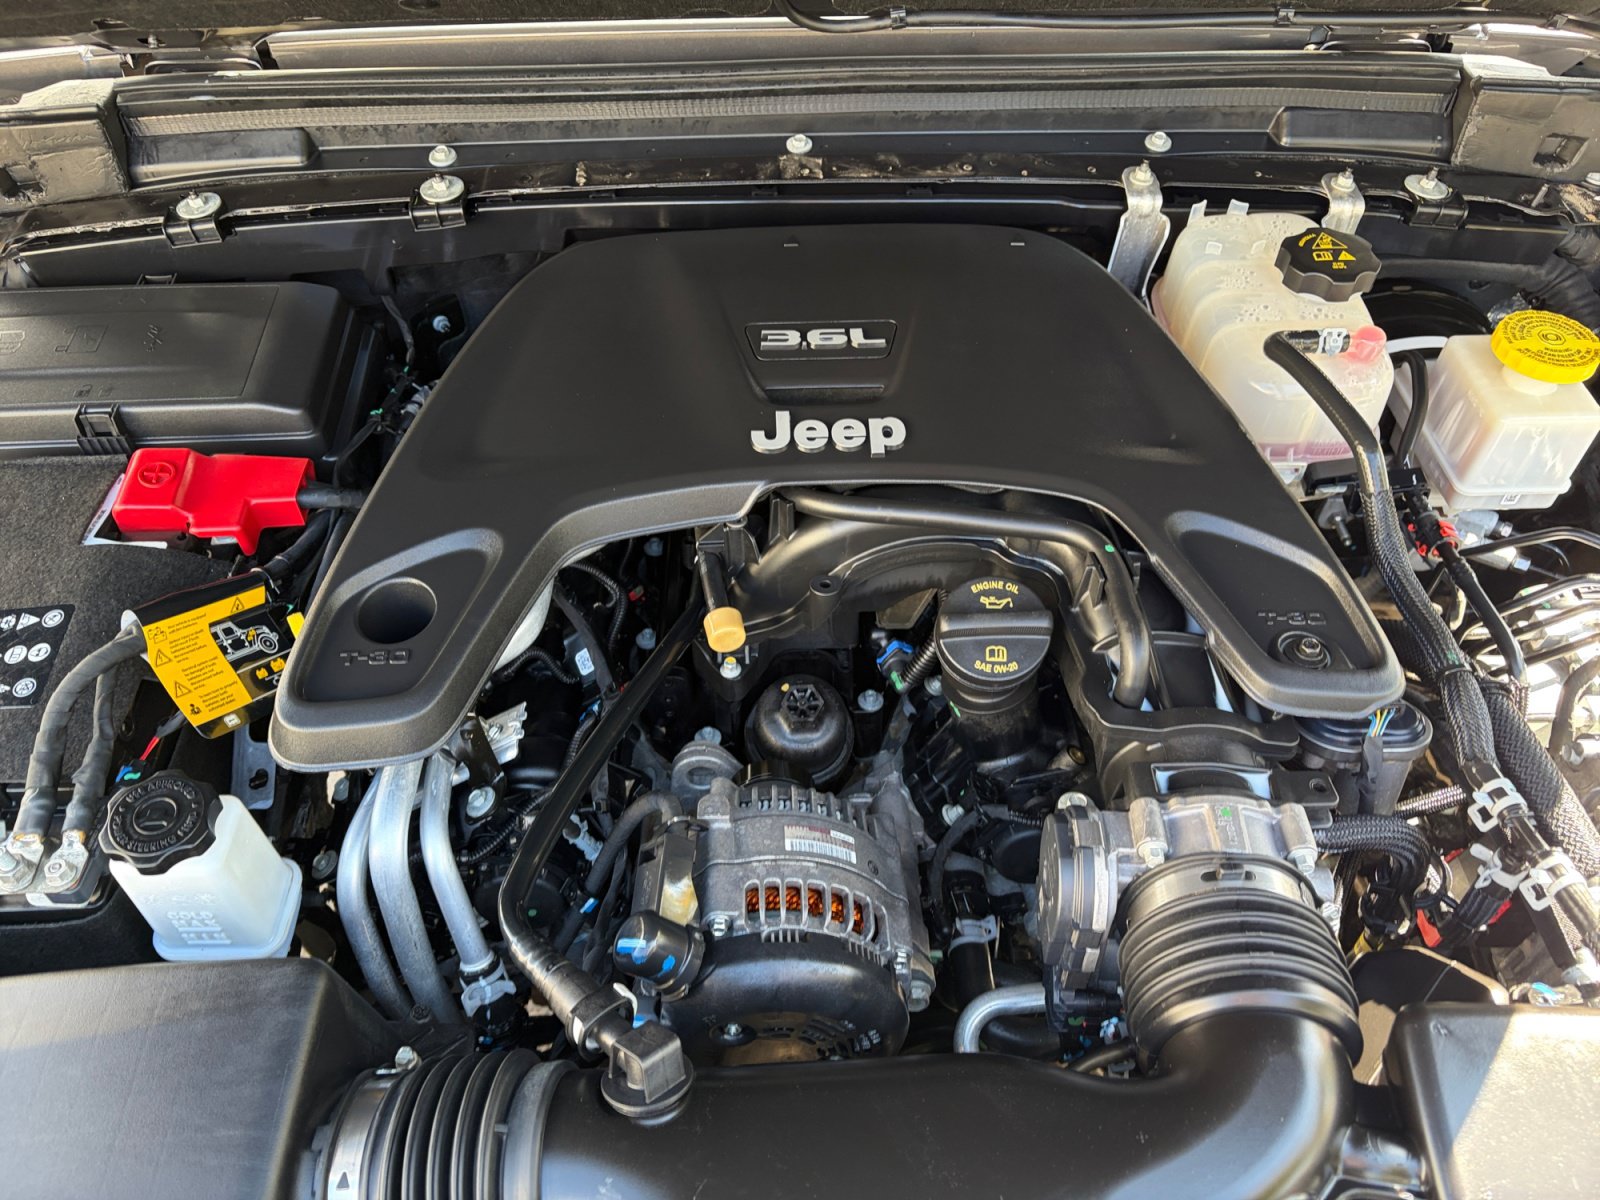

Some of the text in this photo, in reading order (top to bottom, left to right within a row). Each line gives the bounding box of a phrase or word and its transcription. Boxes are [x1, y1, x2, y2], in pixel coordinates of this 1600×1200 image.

[760, 328, 887, 350] 3.6L
[751, 410, 906, 458] Jeep
[971, 581, 1019, 595] ENGINE OIL
[974, 660, 1019, 674] SAE 0W-20
[167, 911, 213, 920] COLD
